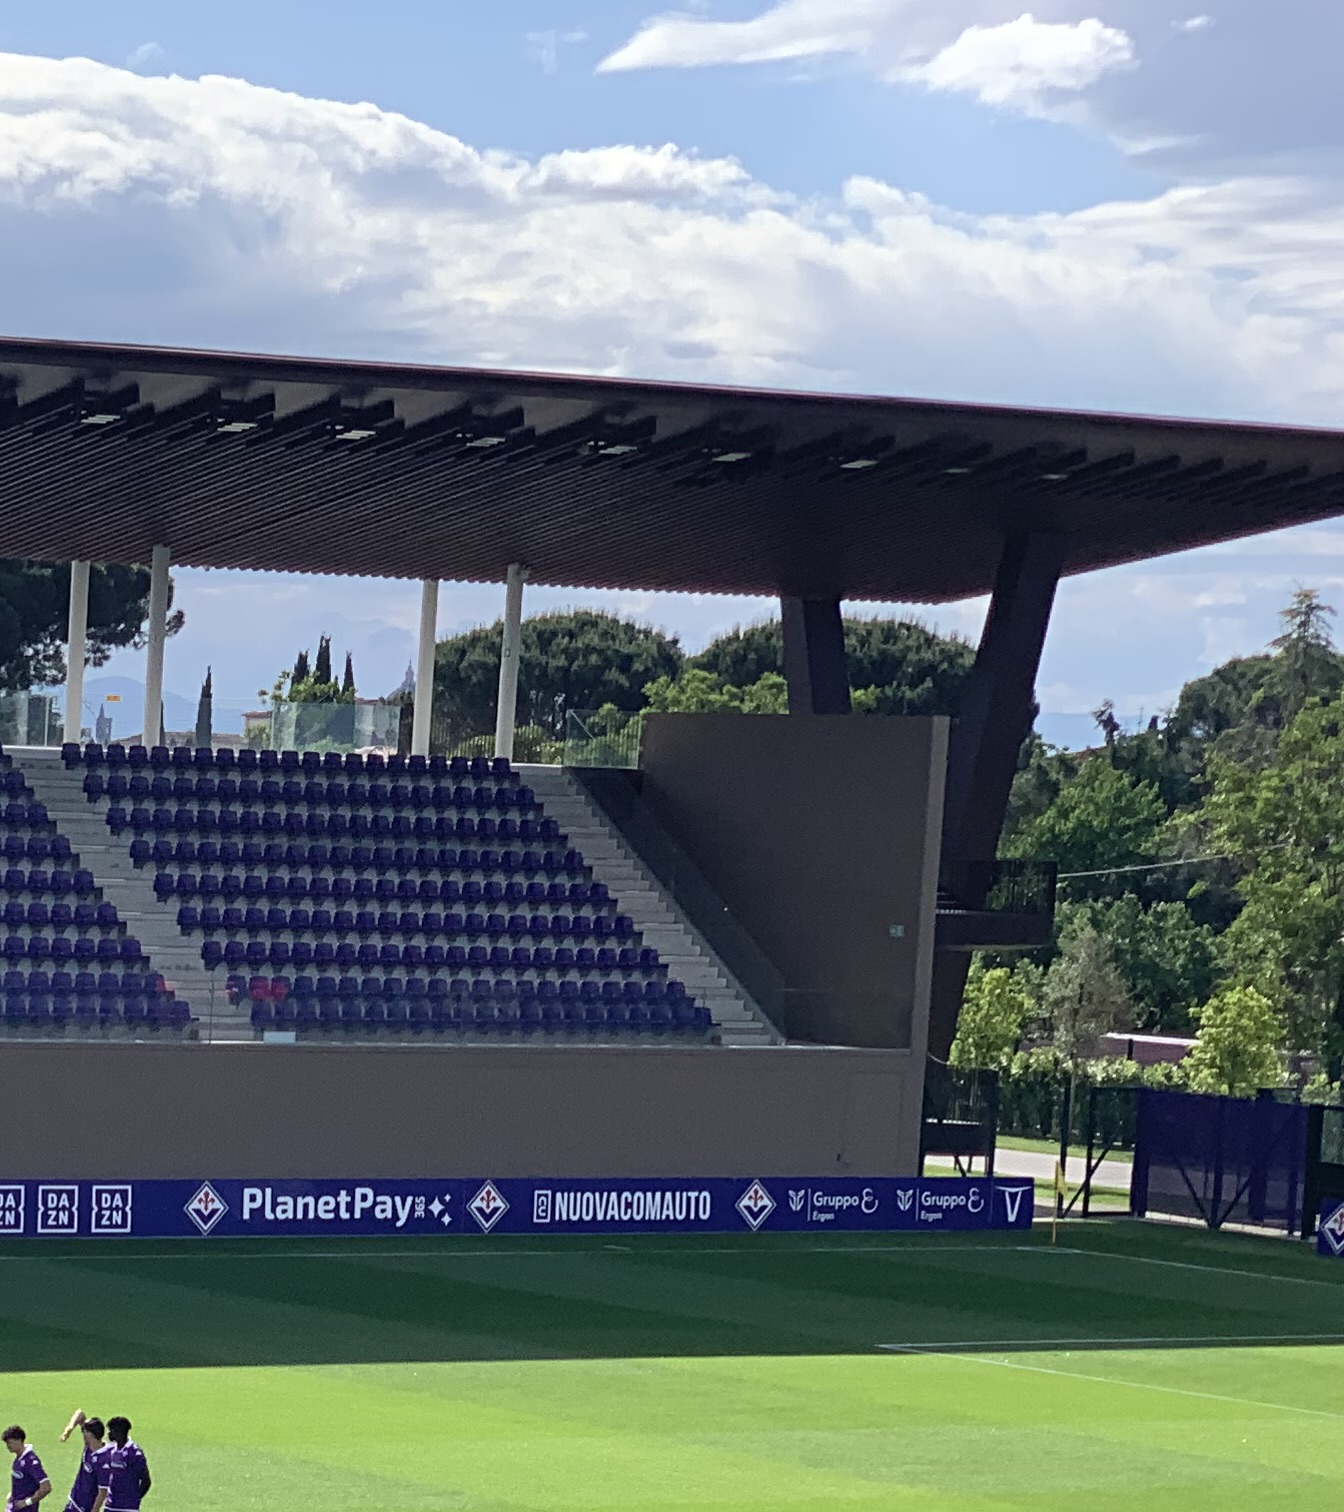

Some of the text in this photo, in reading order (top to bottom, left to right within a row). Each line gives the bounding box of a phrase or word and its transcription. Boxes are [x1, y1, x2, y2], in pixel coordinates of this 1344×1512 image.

[242, 1187, 414, 1228] PlanetPay
[555, 1191, 712, 1221] NUOVACOMAUTO
[813, 1191, 860, 1210] Gruppo
[921, 1191, 967, 1209] Gruppo
